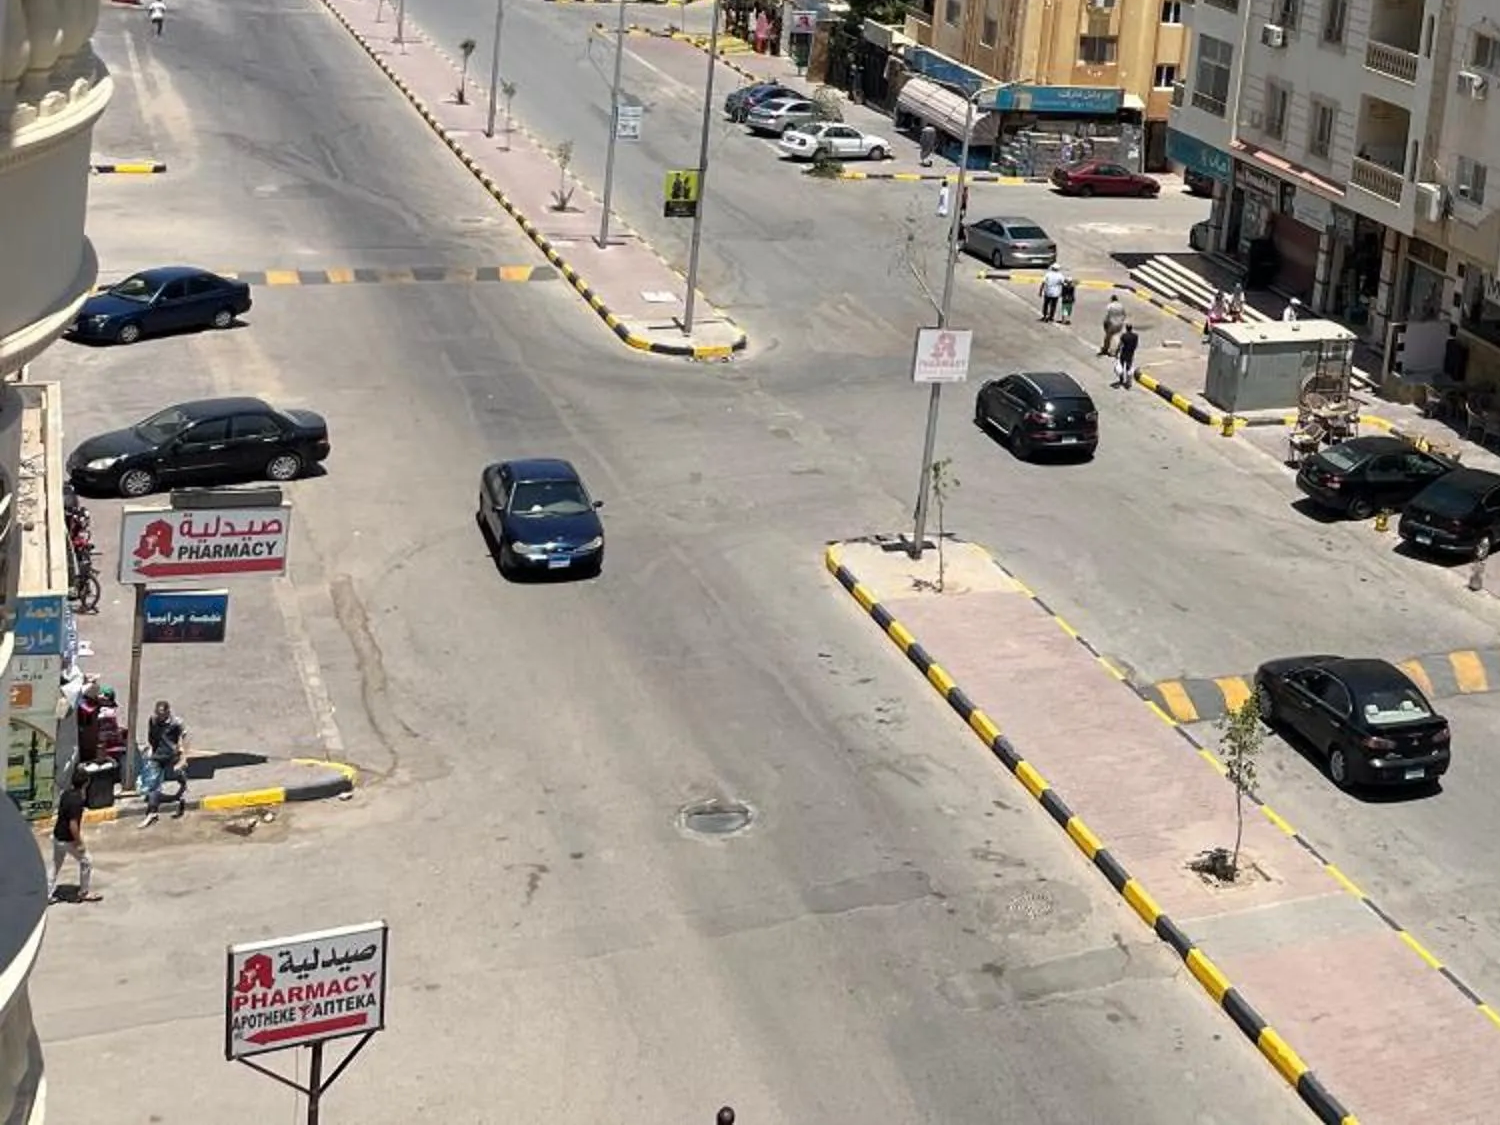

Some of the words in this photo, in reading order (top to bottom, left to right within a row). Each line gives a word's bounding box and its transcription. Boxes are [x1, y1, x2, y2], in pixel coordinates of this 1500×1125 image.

[179, 512, 283, 544] صيدلية
[177, 541, 278, 561] PHARMACY
[277, 943, 378, 980] صيدلية
[232, 971, 378, 1012] PHARMACY
[231, 1005, 297, 1031] APOTHEKE
